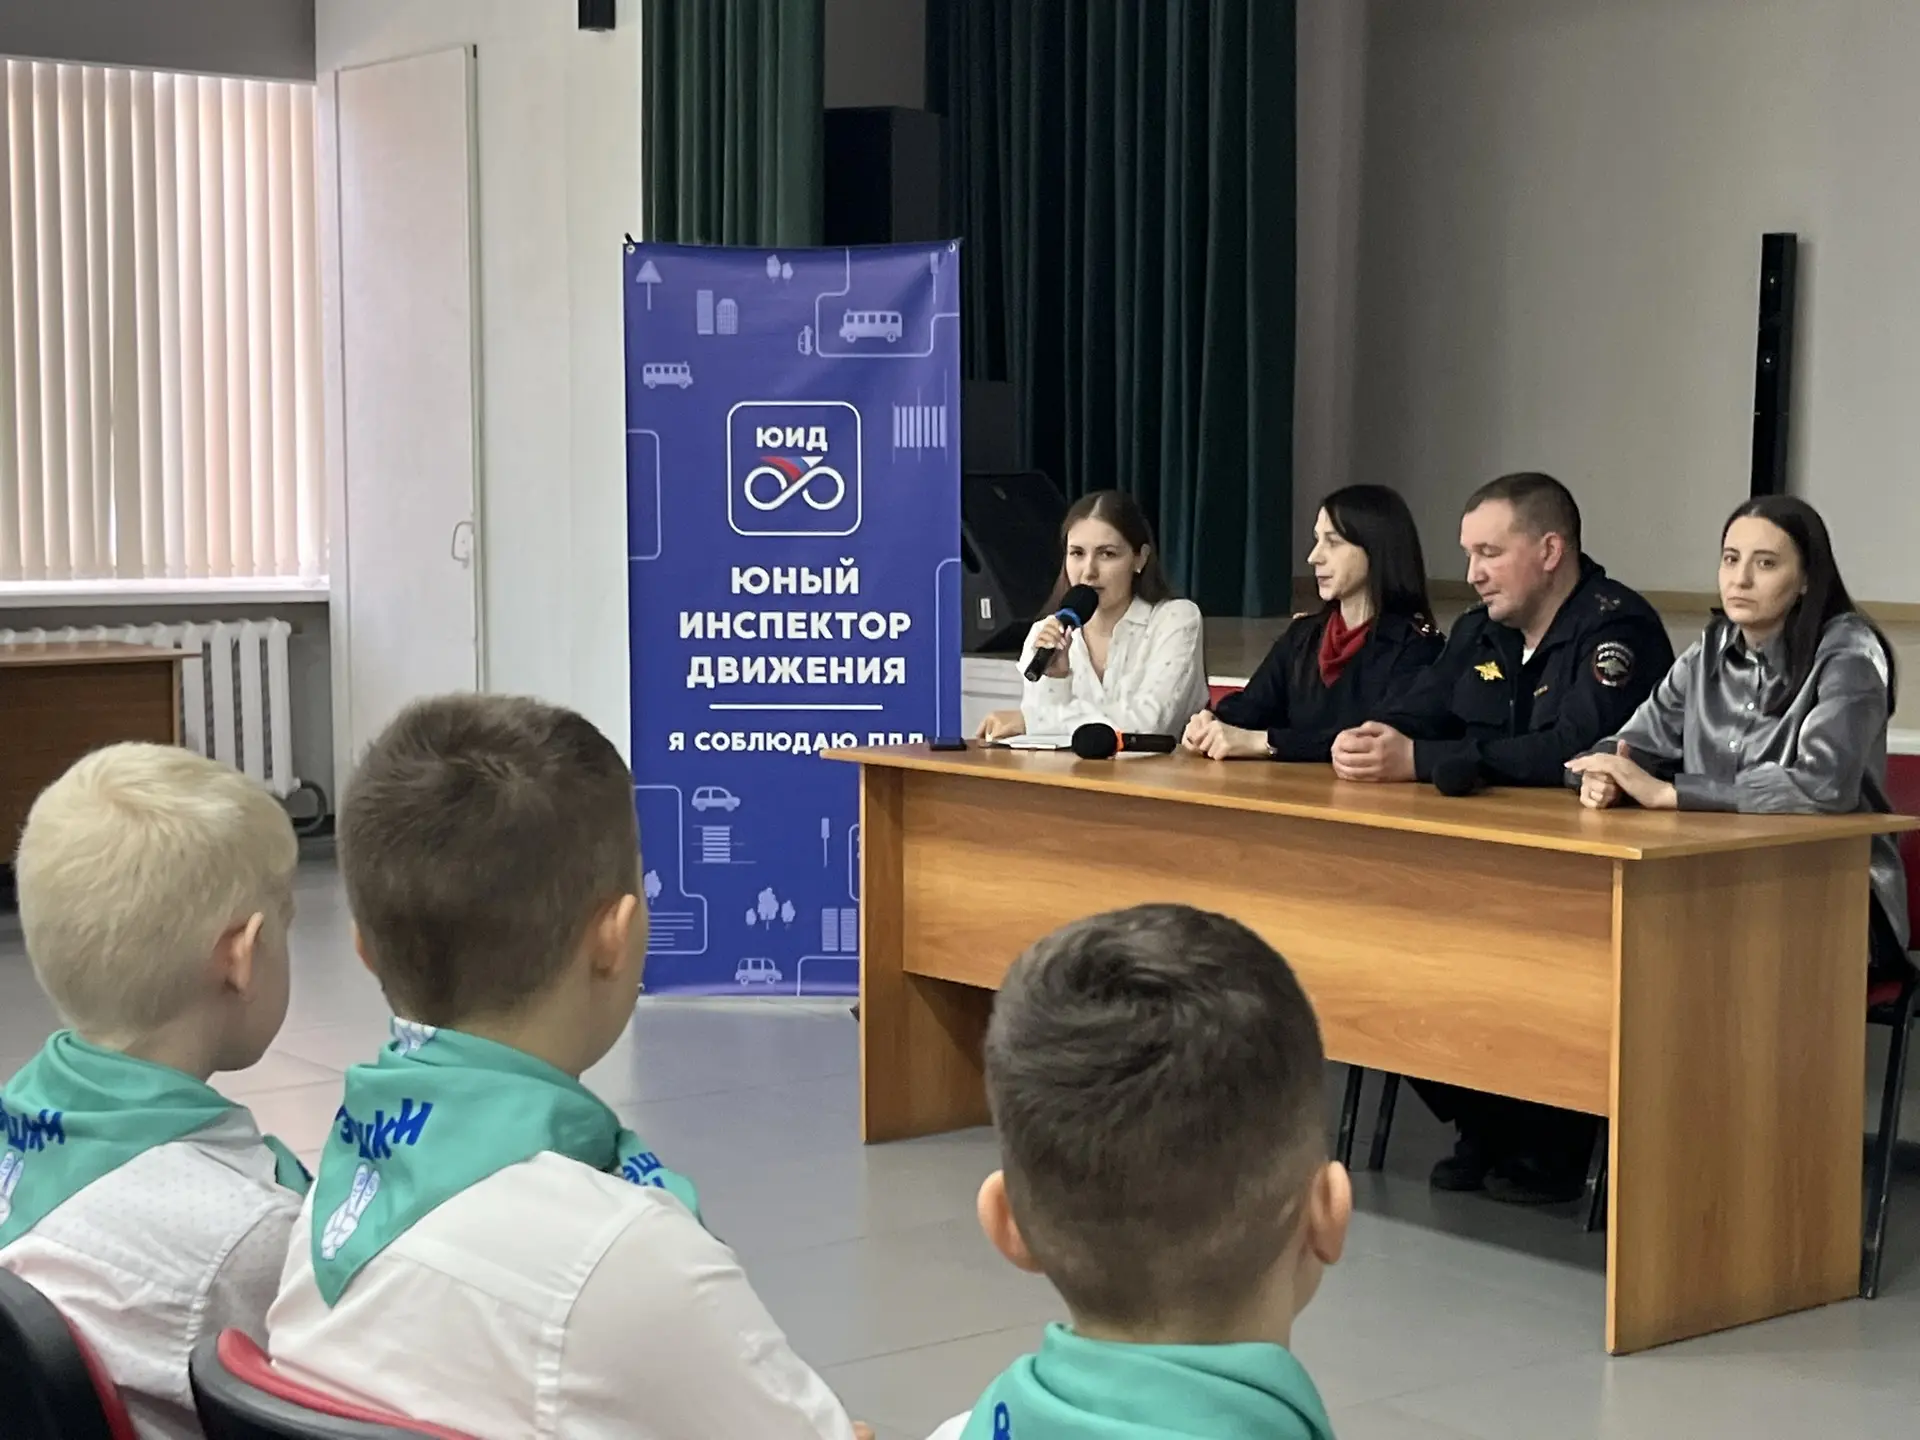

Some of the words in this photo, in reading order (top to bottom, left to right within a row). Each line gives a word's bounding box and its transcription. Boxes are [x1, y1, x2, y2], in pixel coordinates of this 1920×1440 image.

[756, 426, 828, 452] ЮИД
[731, 557, 859, 595] ЮНЫЙ
[679, 611, 911, 640] ИНСПЕКТОР
[686, 656, 906, 689] ДВИЖЕНИЯ
[668, 732, 685, 751] Я
[694, 732, 858, 755] СОБЛЮДАЮ
